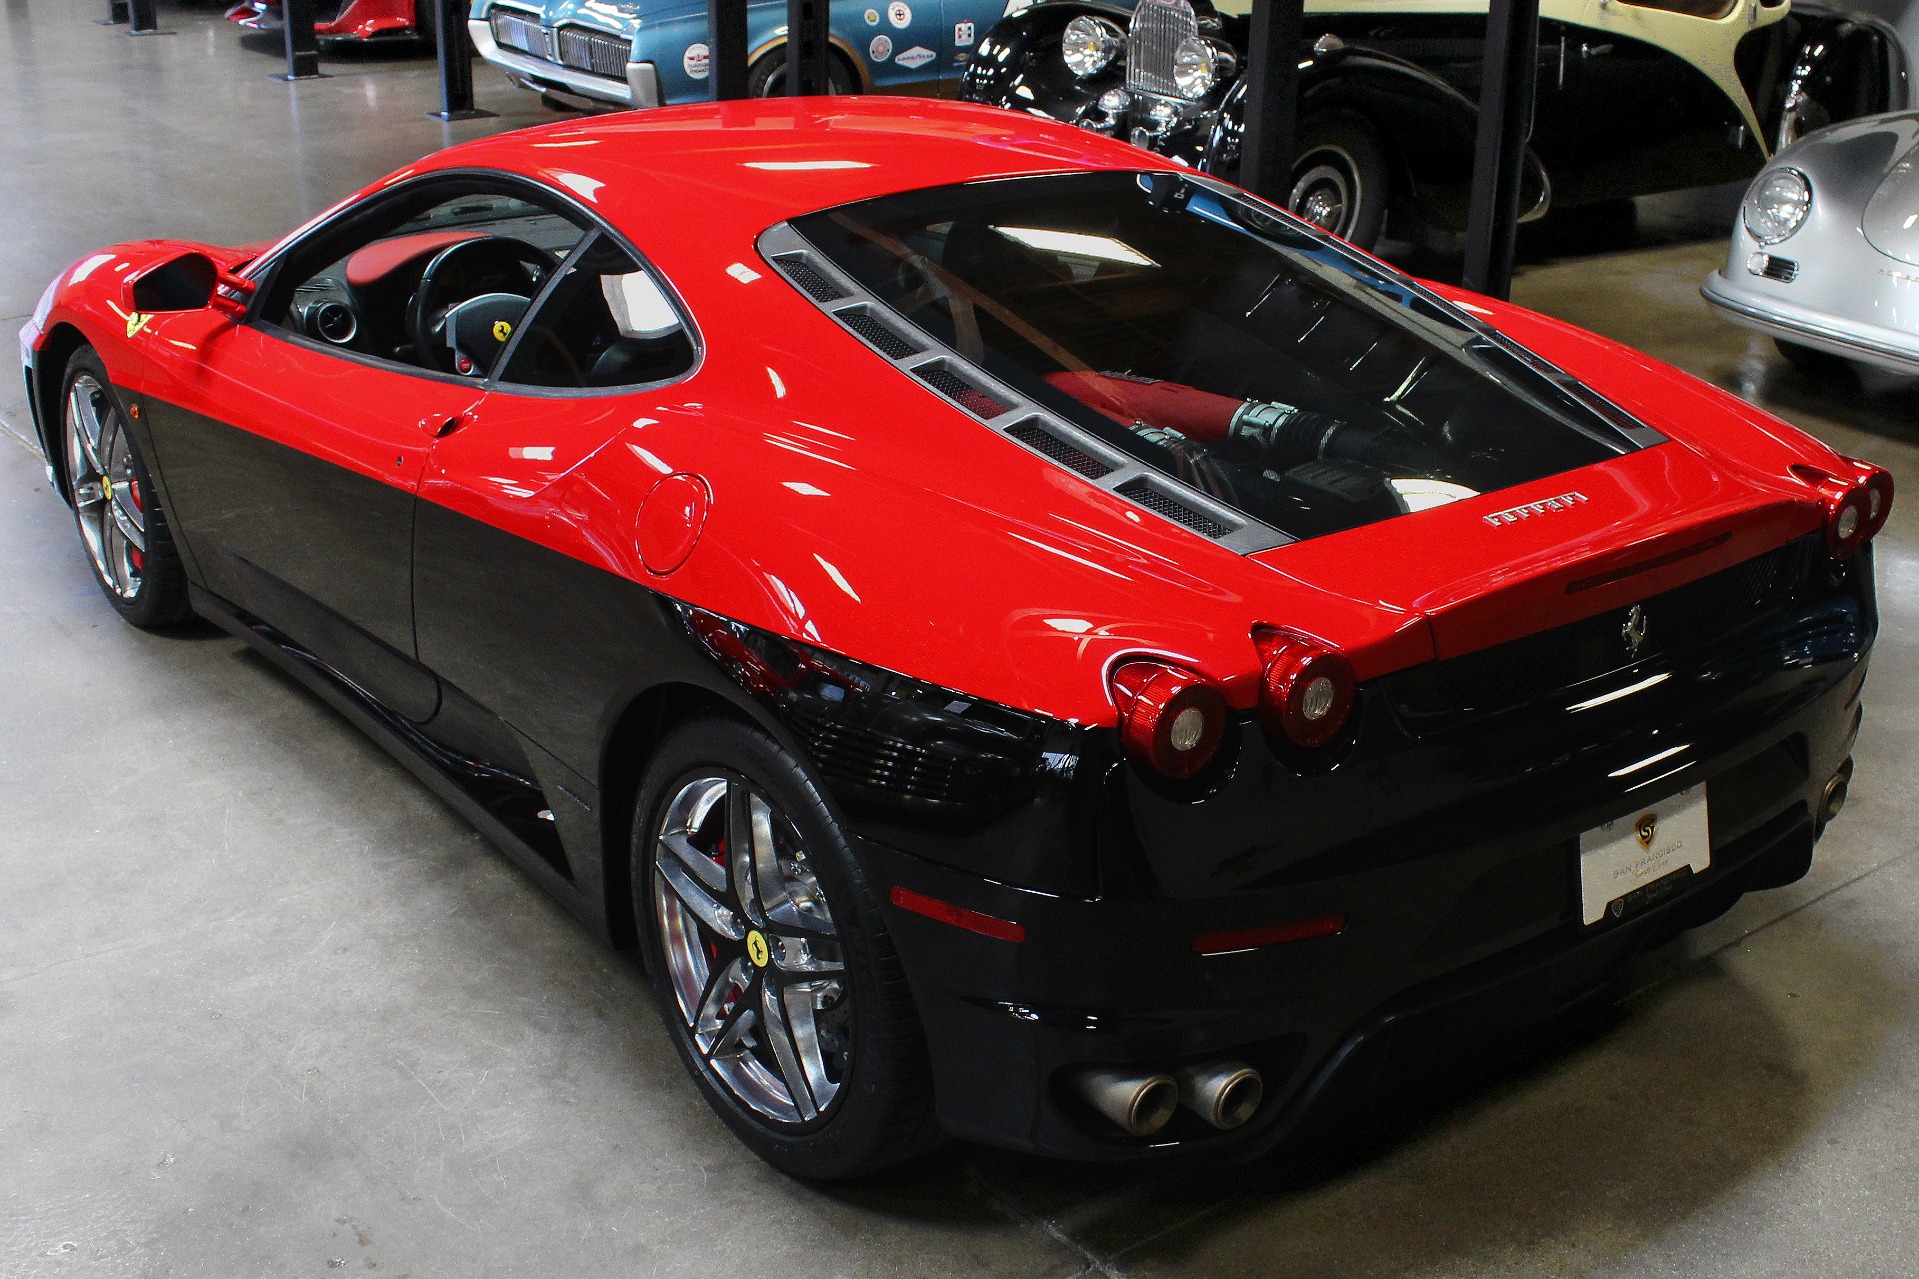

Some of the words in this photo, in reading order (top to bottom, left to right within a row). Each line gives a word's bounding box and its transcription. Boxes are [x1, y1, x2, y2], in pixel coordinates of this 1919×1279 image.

[1483, 491, 1589, 527] Ferrari
[1613, 865, 1632, 879] SAN
[1635, 841, 1683, 868] FRANCISCO
